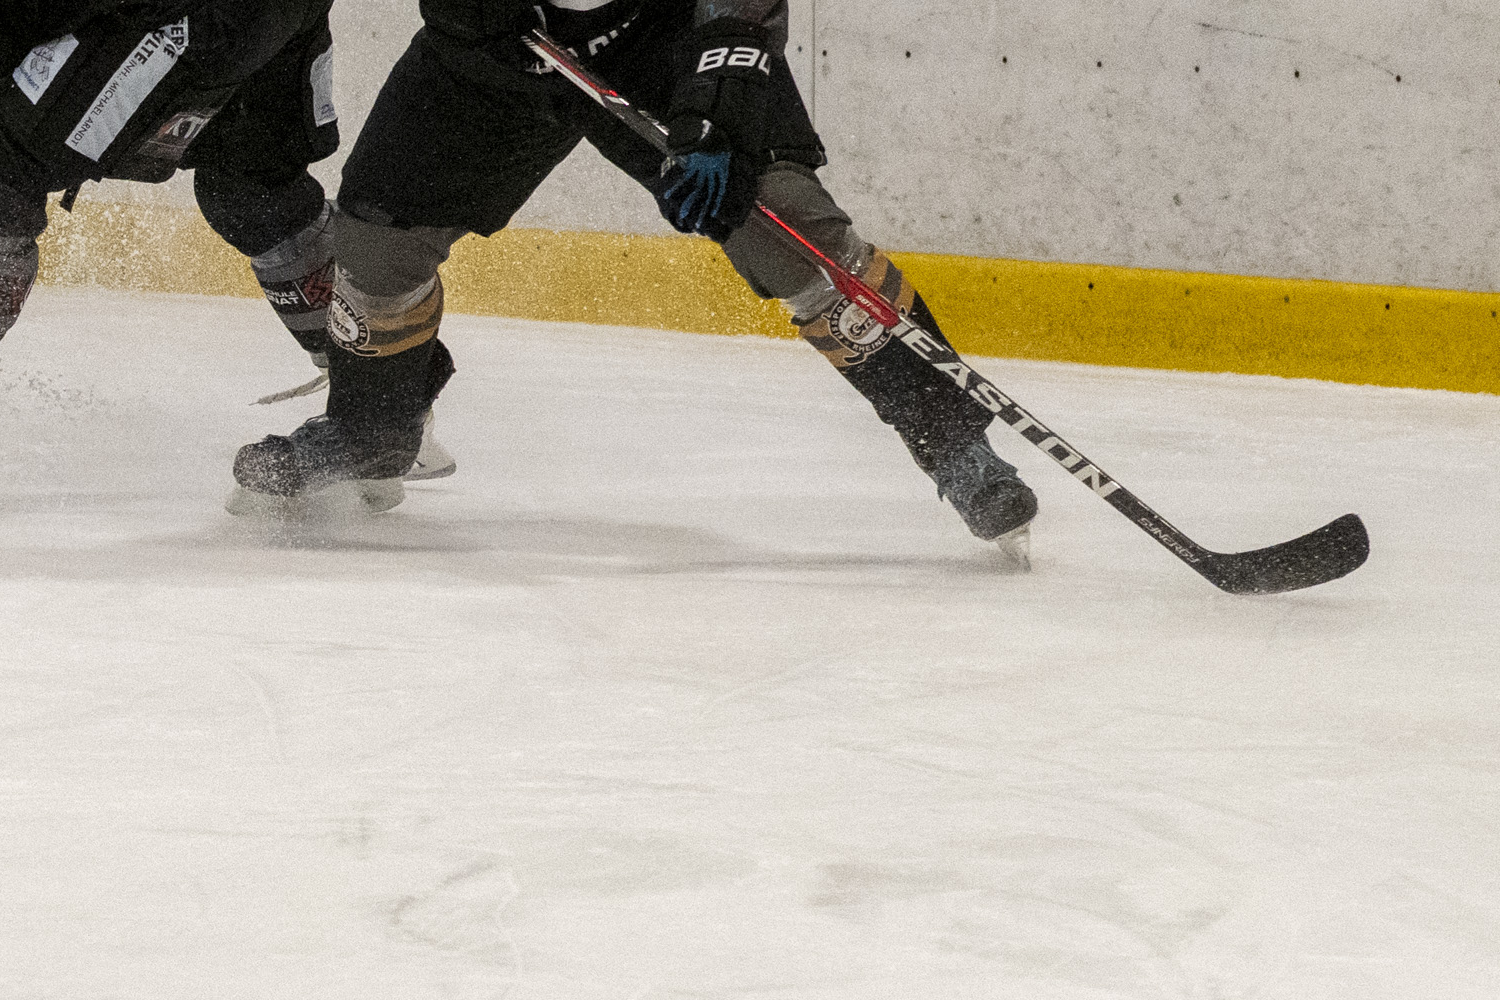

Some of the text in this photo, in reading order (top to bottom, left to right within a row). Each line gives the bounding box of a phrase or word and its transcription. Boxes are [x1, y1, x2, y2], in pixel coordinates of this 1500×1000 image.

[91, 81, 120, 117] MICHAEL
[71, 118, 95, 147] ARNDT
[901, 327, 1122, 500] EASTON
[1137, 516, 1201, 564] SYNERGY
